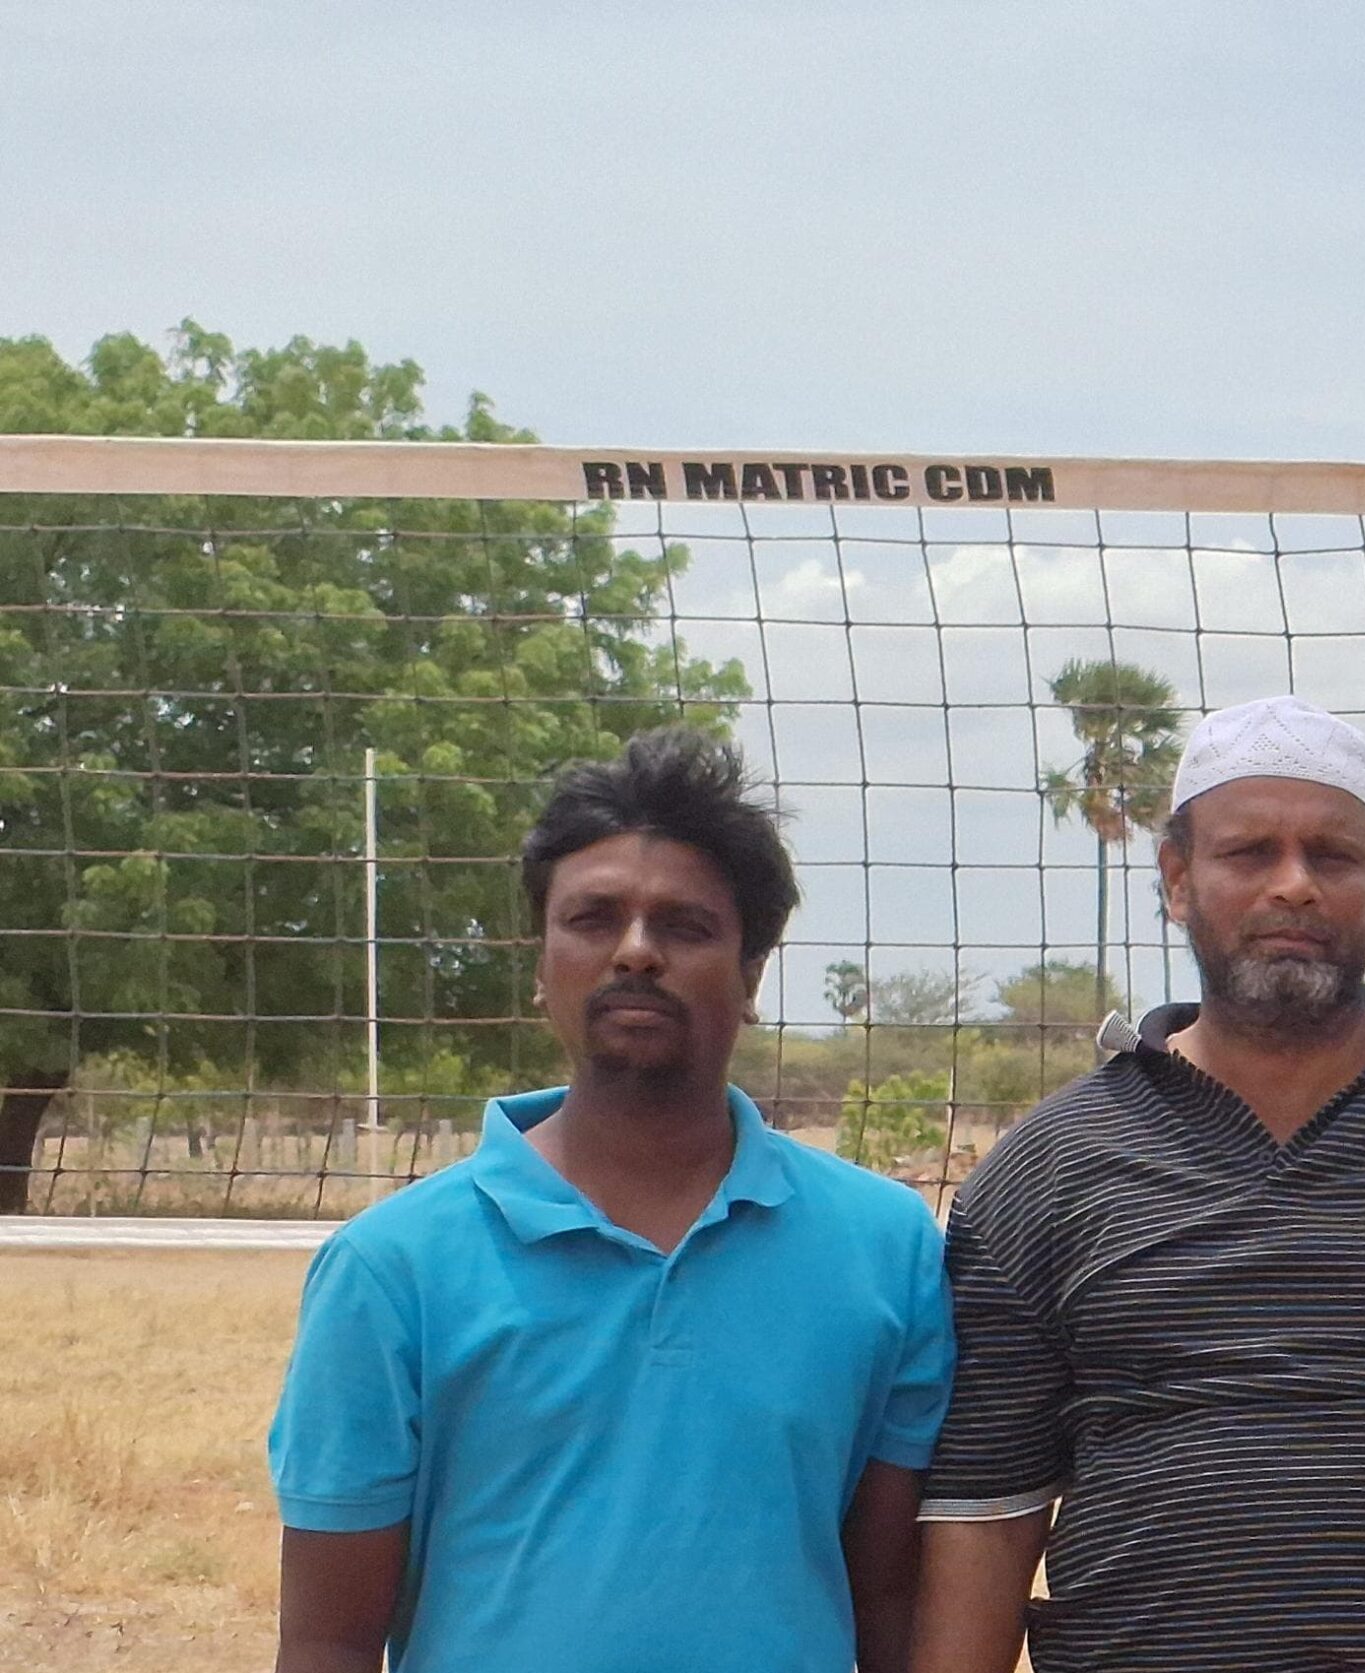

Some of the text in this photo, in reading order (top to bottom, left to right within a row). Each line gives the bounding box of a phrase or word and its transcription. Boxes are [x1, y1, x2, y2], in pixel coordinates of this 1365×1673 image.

[582, 461, 1056, 503] RN MATRIC CDM
